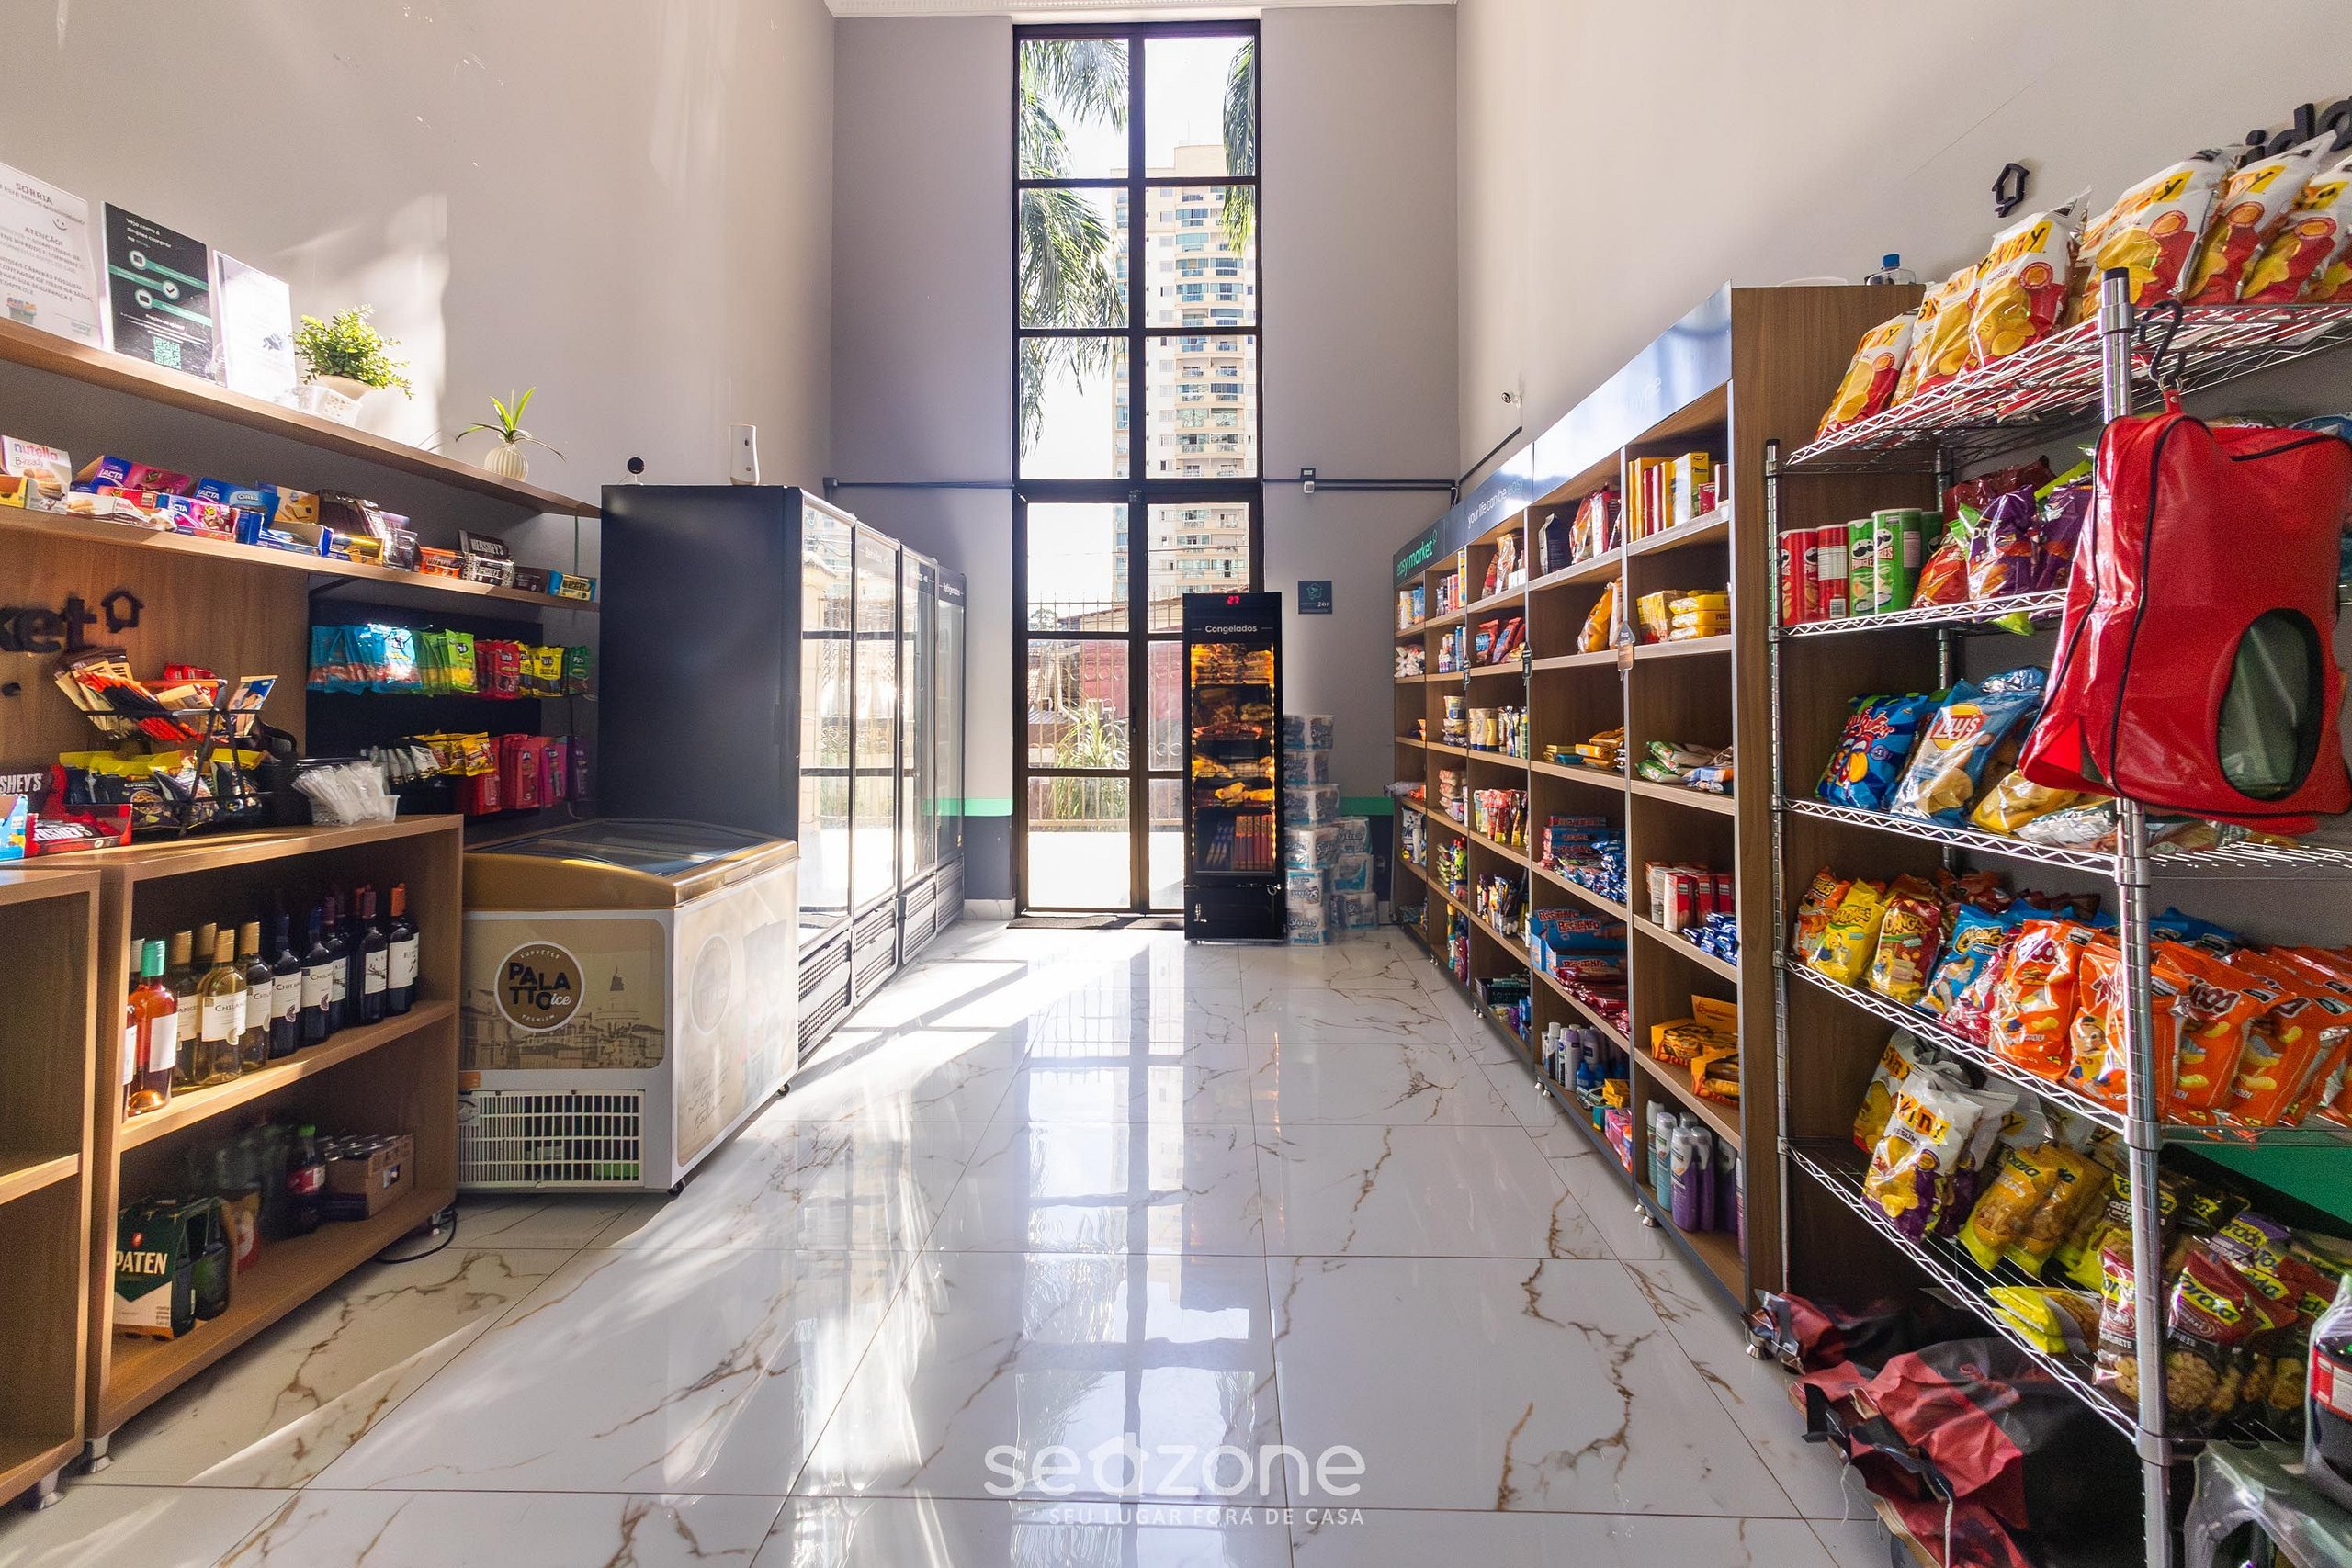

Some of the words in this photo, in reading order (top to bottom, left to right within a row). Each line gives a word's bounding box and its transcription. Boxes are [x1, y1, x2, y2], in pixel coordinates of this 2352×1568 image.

[14, 442, 59, 461] nutella
[98, 468, 124, 480] LACTA
[198, 489, 220, 500] LACTA
[1498, 488, 1508, 503] be
[1396, 557, 1408, 578] easy
[1408, 536, 1433, 569] market
[1204, 625, 1258, 635] Congelados
[550, 992, 572, 1006] ice
